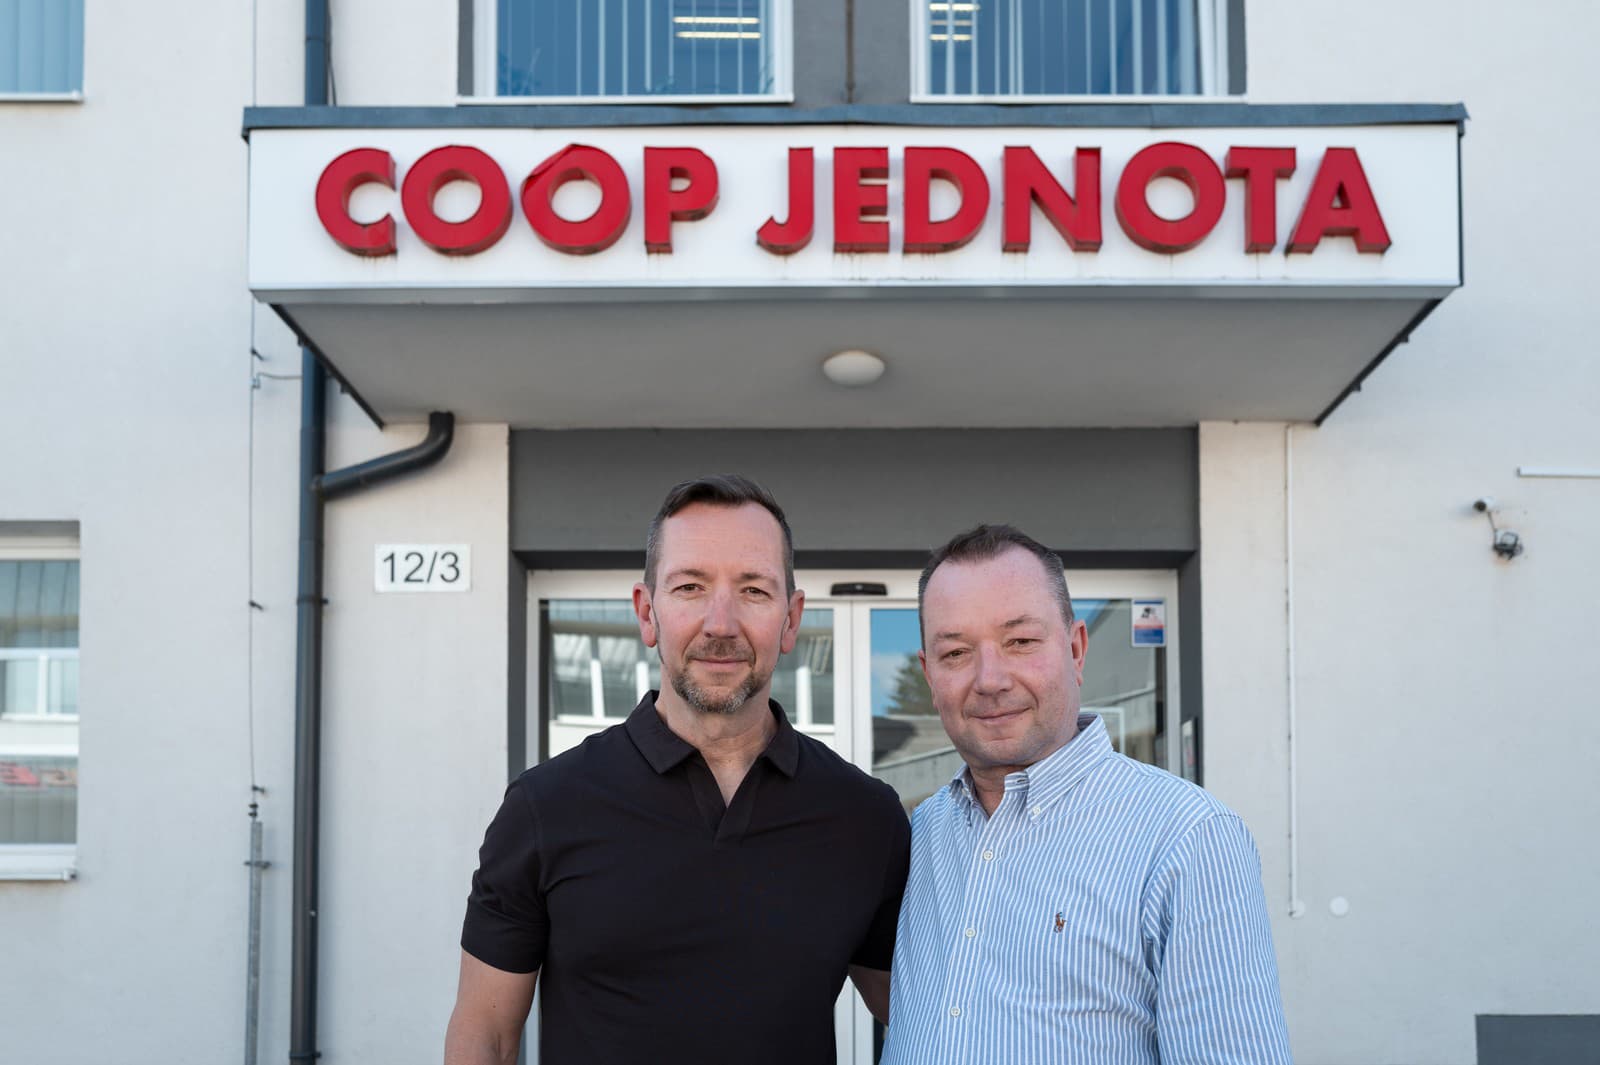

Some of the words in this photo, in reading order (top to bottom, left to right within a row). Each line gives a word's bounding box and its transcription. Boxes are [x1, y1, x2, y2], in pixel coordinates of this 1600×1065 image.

[315, 143, 719, 256] COOP
[757, 142, 1391, 255] JEDNOTA
[383, 551, 460, 583] 12/3
